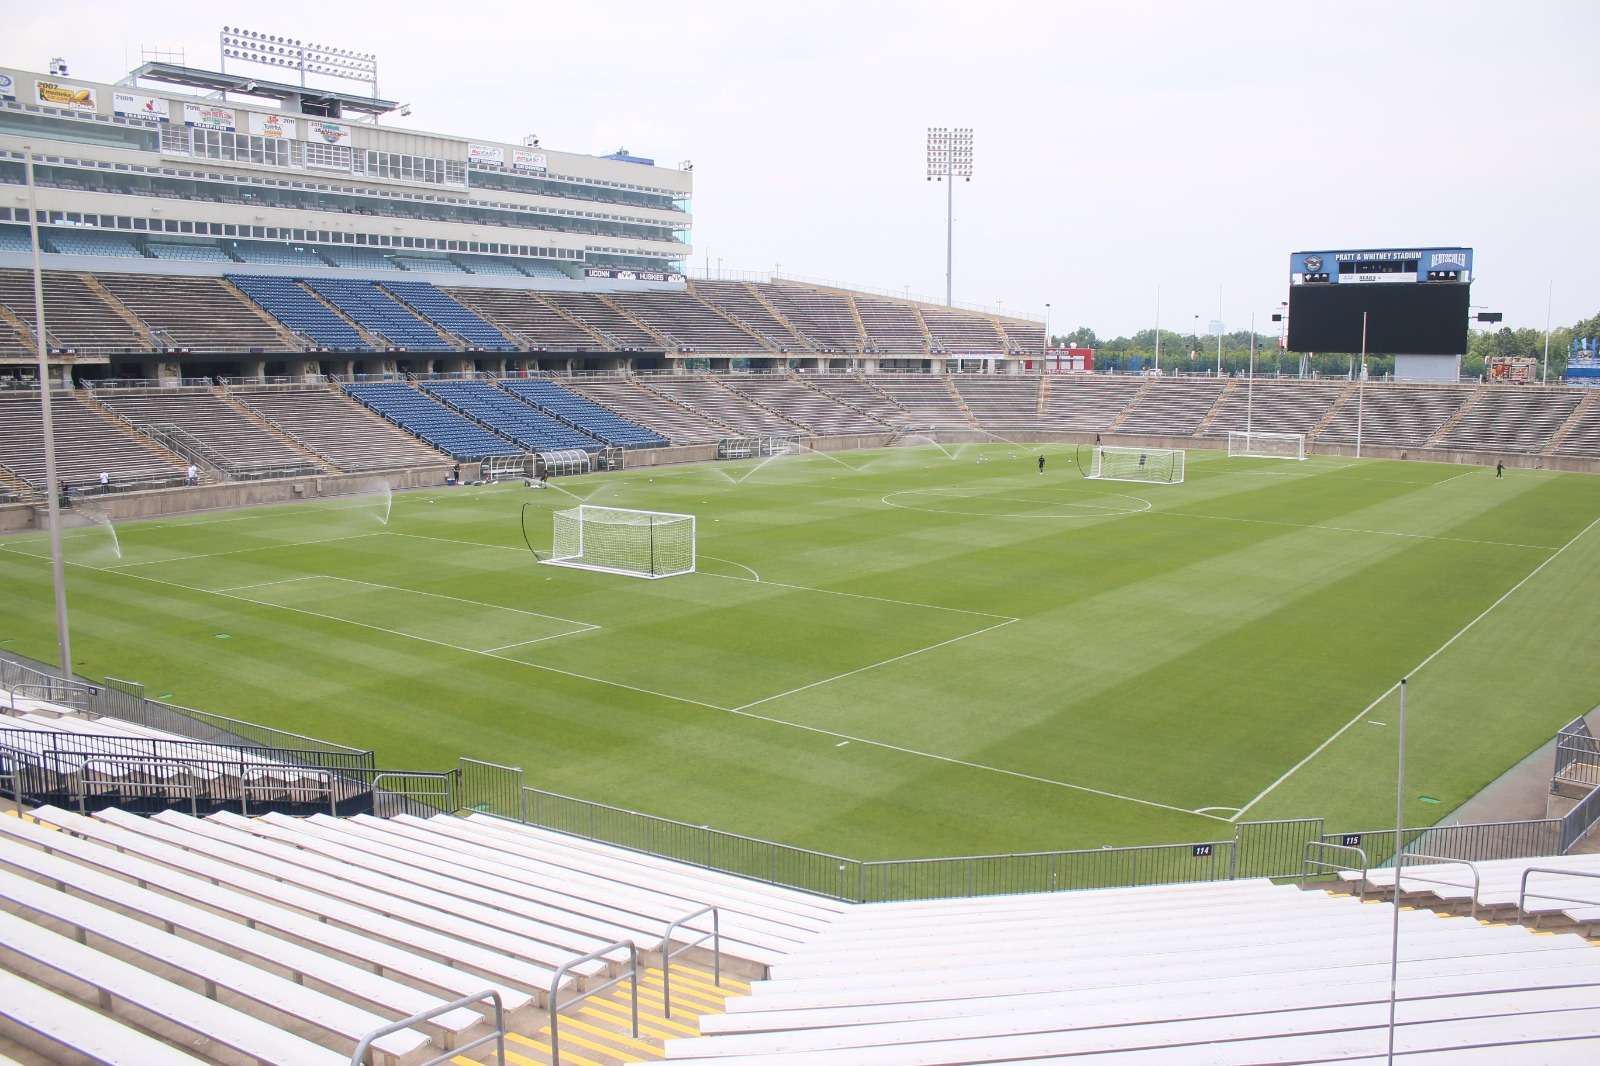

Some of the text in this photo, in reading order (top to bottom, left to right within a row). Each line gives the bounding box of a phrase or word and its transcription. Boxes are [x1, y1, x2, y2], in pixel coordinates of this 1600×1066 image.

[37, 82, 59, 90] 2007
[1335, 253, 1354, 261] PRATT
[1363, 252, 1391, 260] WHITNEY
[1393, 251, 1422, 259] STADIUM
[639, 273, 664, 281] HUSKIES
[1346, 836, 1359, 845] 115
[1196, 847, 1209, 855] 114
